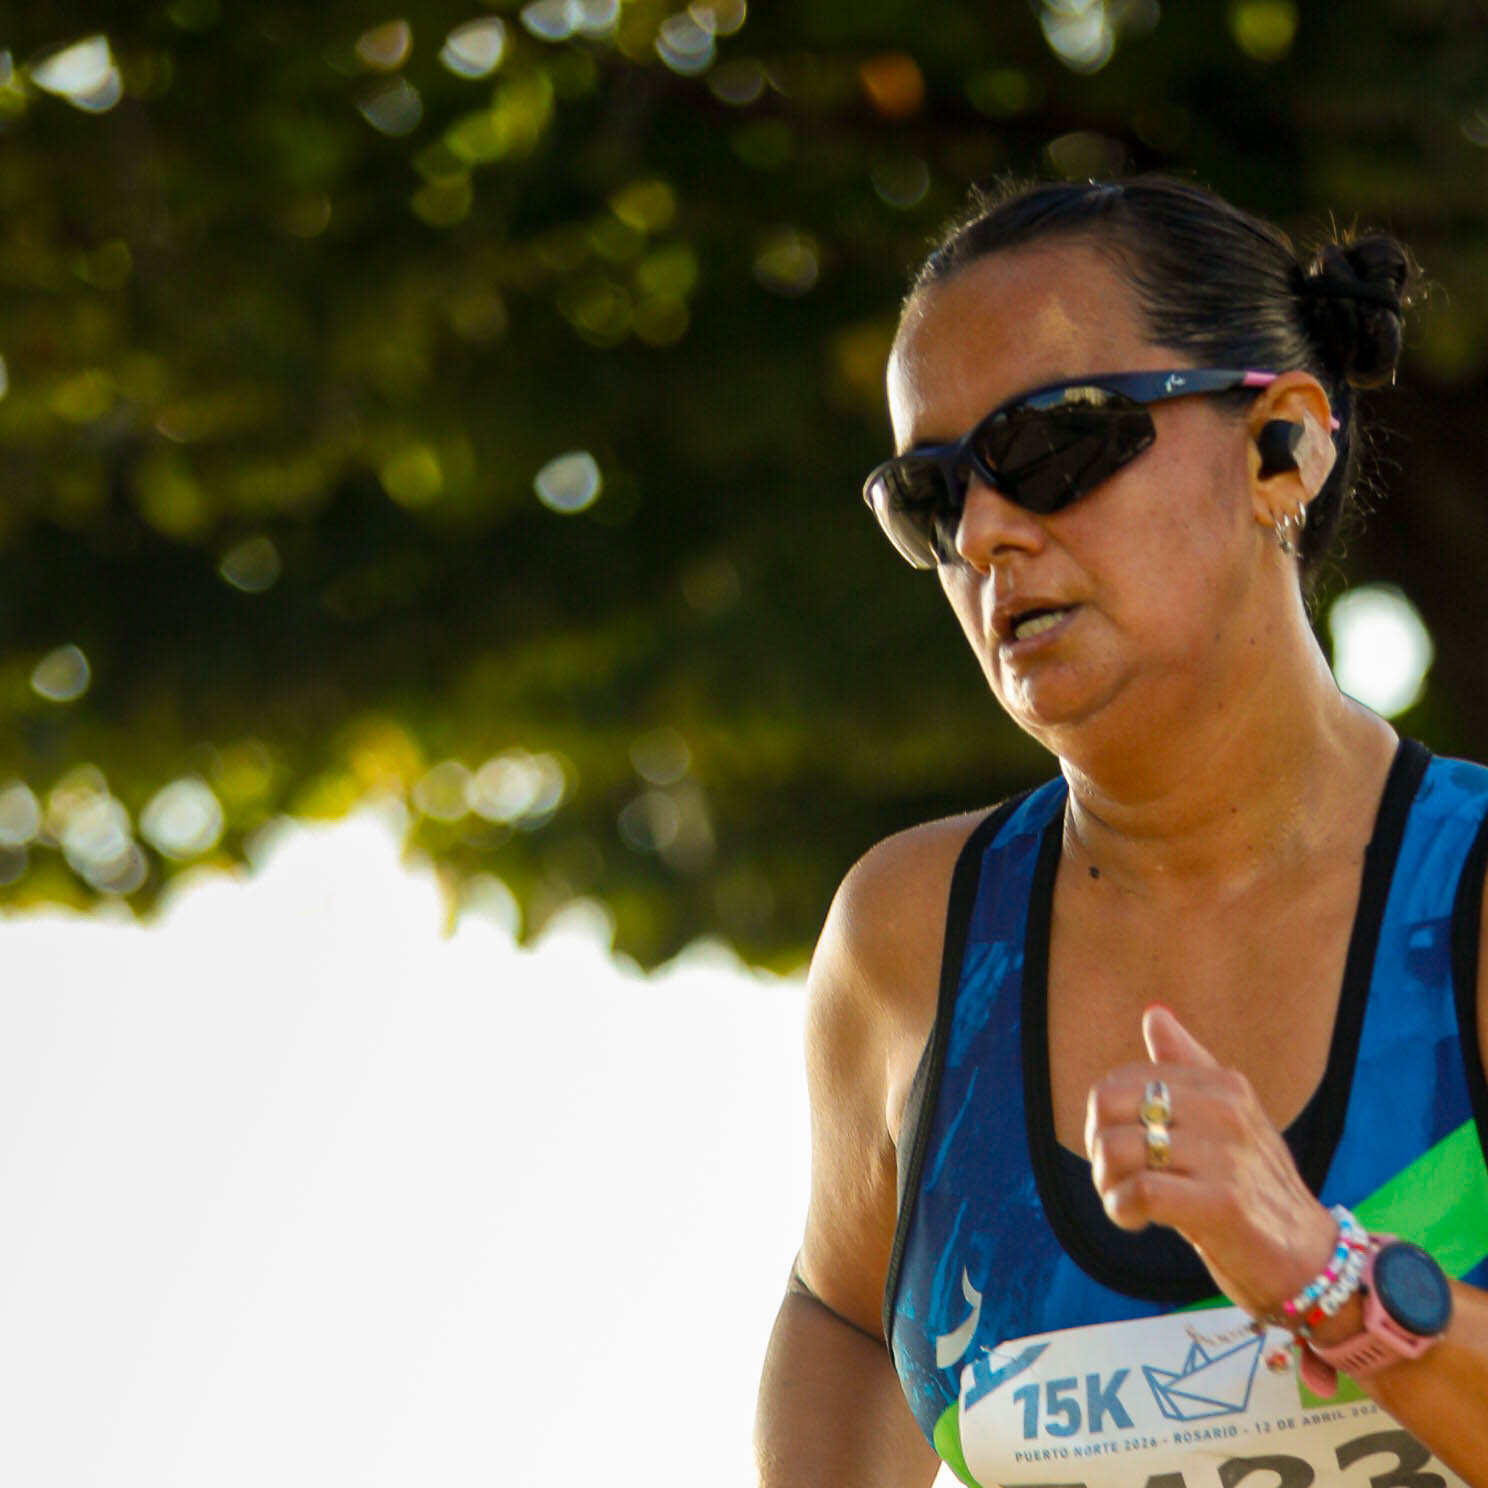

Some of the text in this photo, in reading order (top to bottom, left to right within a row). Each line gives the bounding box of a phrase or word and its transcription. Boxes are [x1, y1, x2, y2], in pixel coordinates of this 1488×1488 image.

[1013, 1368, 1135, 1440] 15K
[1015, 1447, 1069, 1463] PUERTO
[1073, 1442, 1119, 1457] NORTE
[1124, 1438, 1158, 1451] 2026
[1174, 1425, 1238, 1444] ROSARIO
[1255, 1422, 1271, 1433] 12
[1277, 1418, 1296, 1430] DE
[1302, 1411, 1346, 1426] ABRIL
[1351, 1403, 1384, 1418] 202
